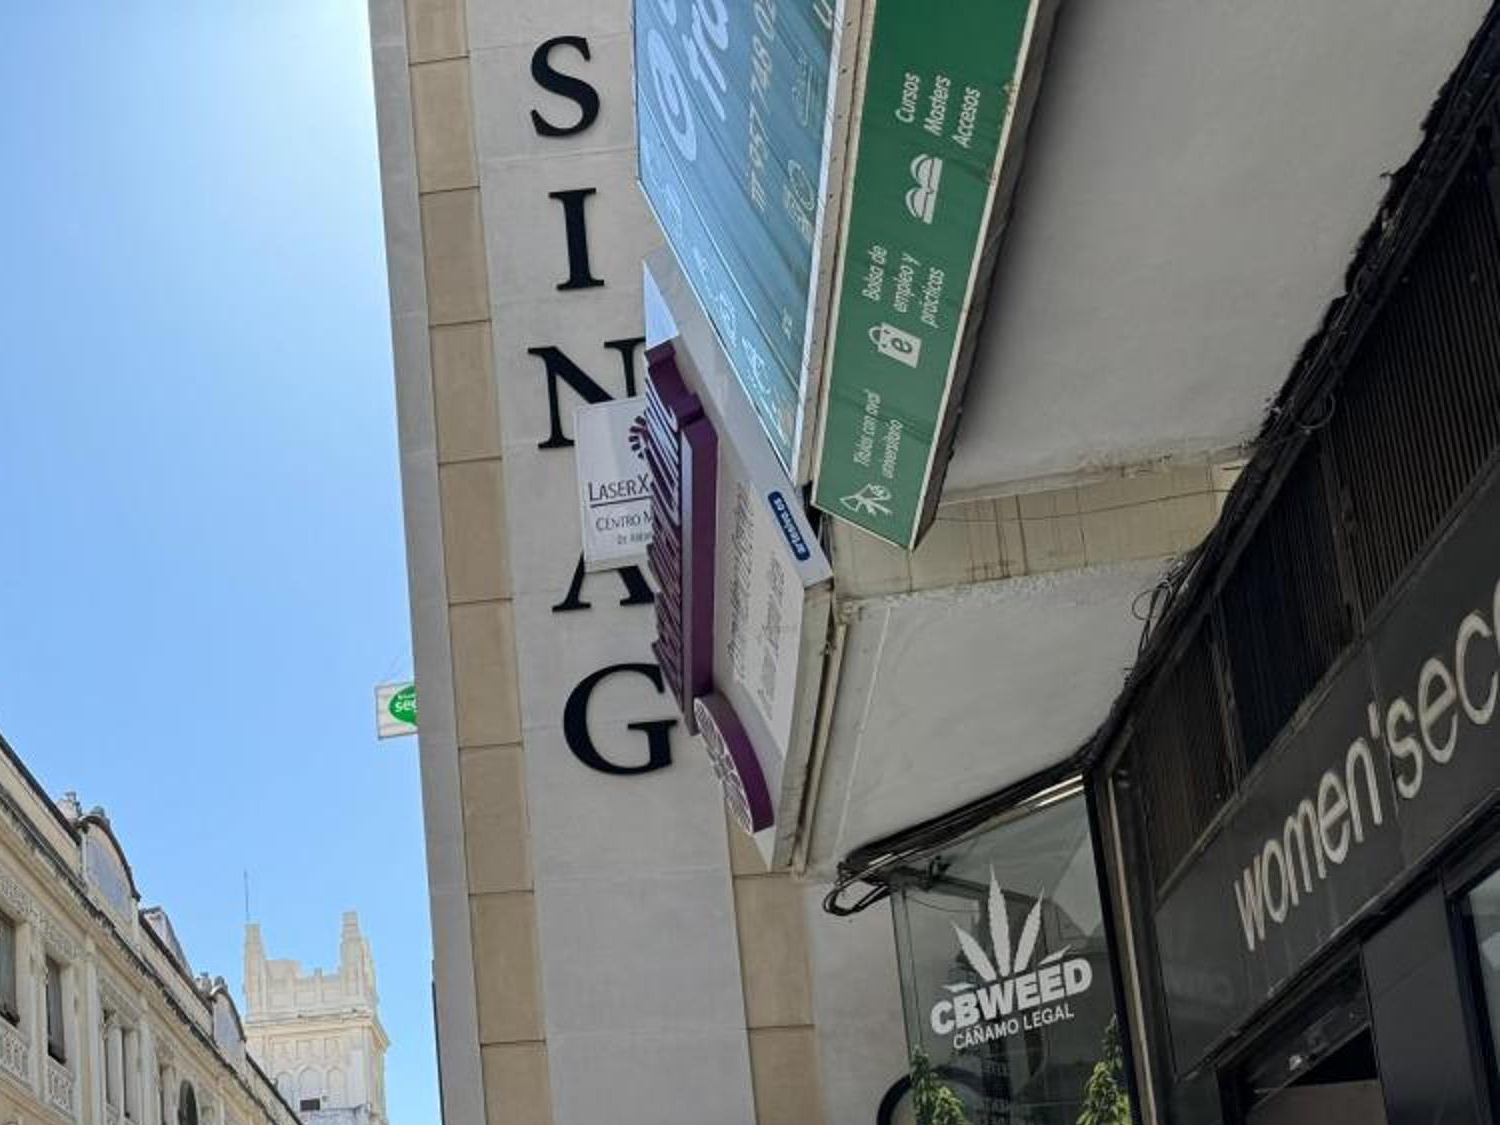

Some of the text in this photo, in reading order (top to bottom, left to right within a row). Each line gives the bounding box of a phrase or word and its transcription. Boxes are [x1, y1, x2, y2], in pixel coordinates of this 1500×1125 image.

[895, 72, 921, 124] Cursos
[924, 75, 951, 136] Masters
[952, 87, 981, 149] Accesos
[862, 245, 888, 301] Bolsa de
[893, 264, 916, 314] empleo
[1232, 575, 1500, 952] women'sec
[929, 957, 1094, 1036] CBWEED
[1023, 1002, 1075, 1030] LEGAL
